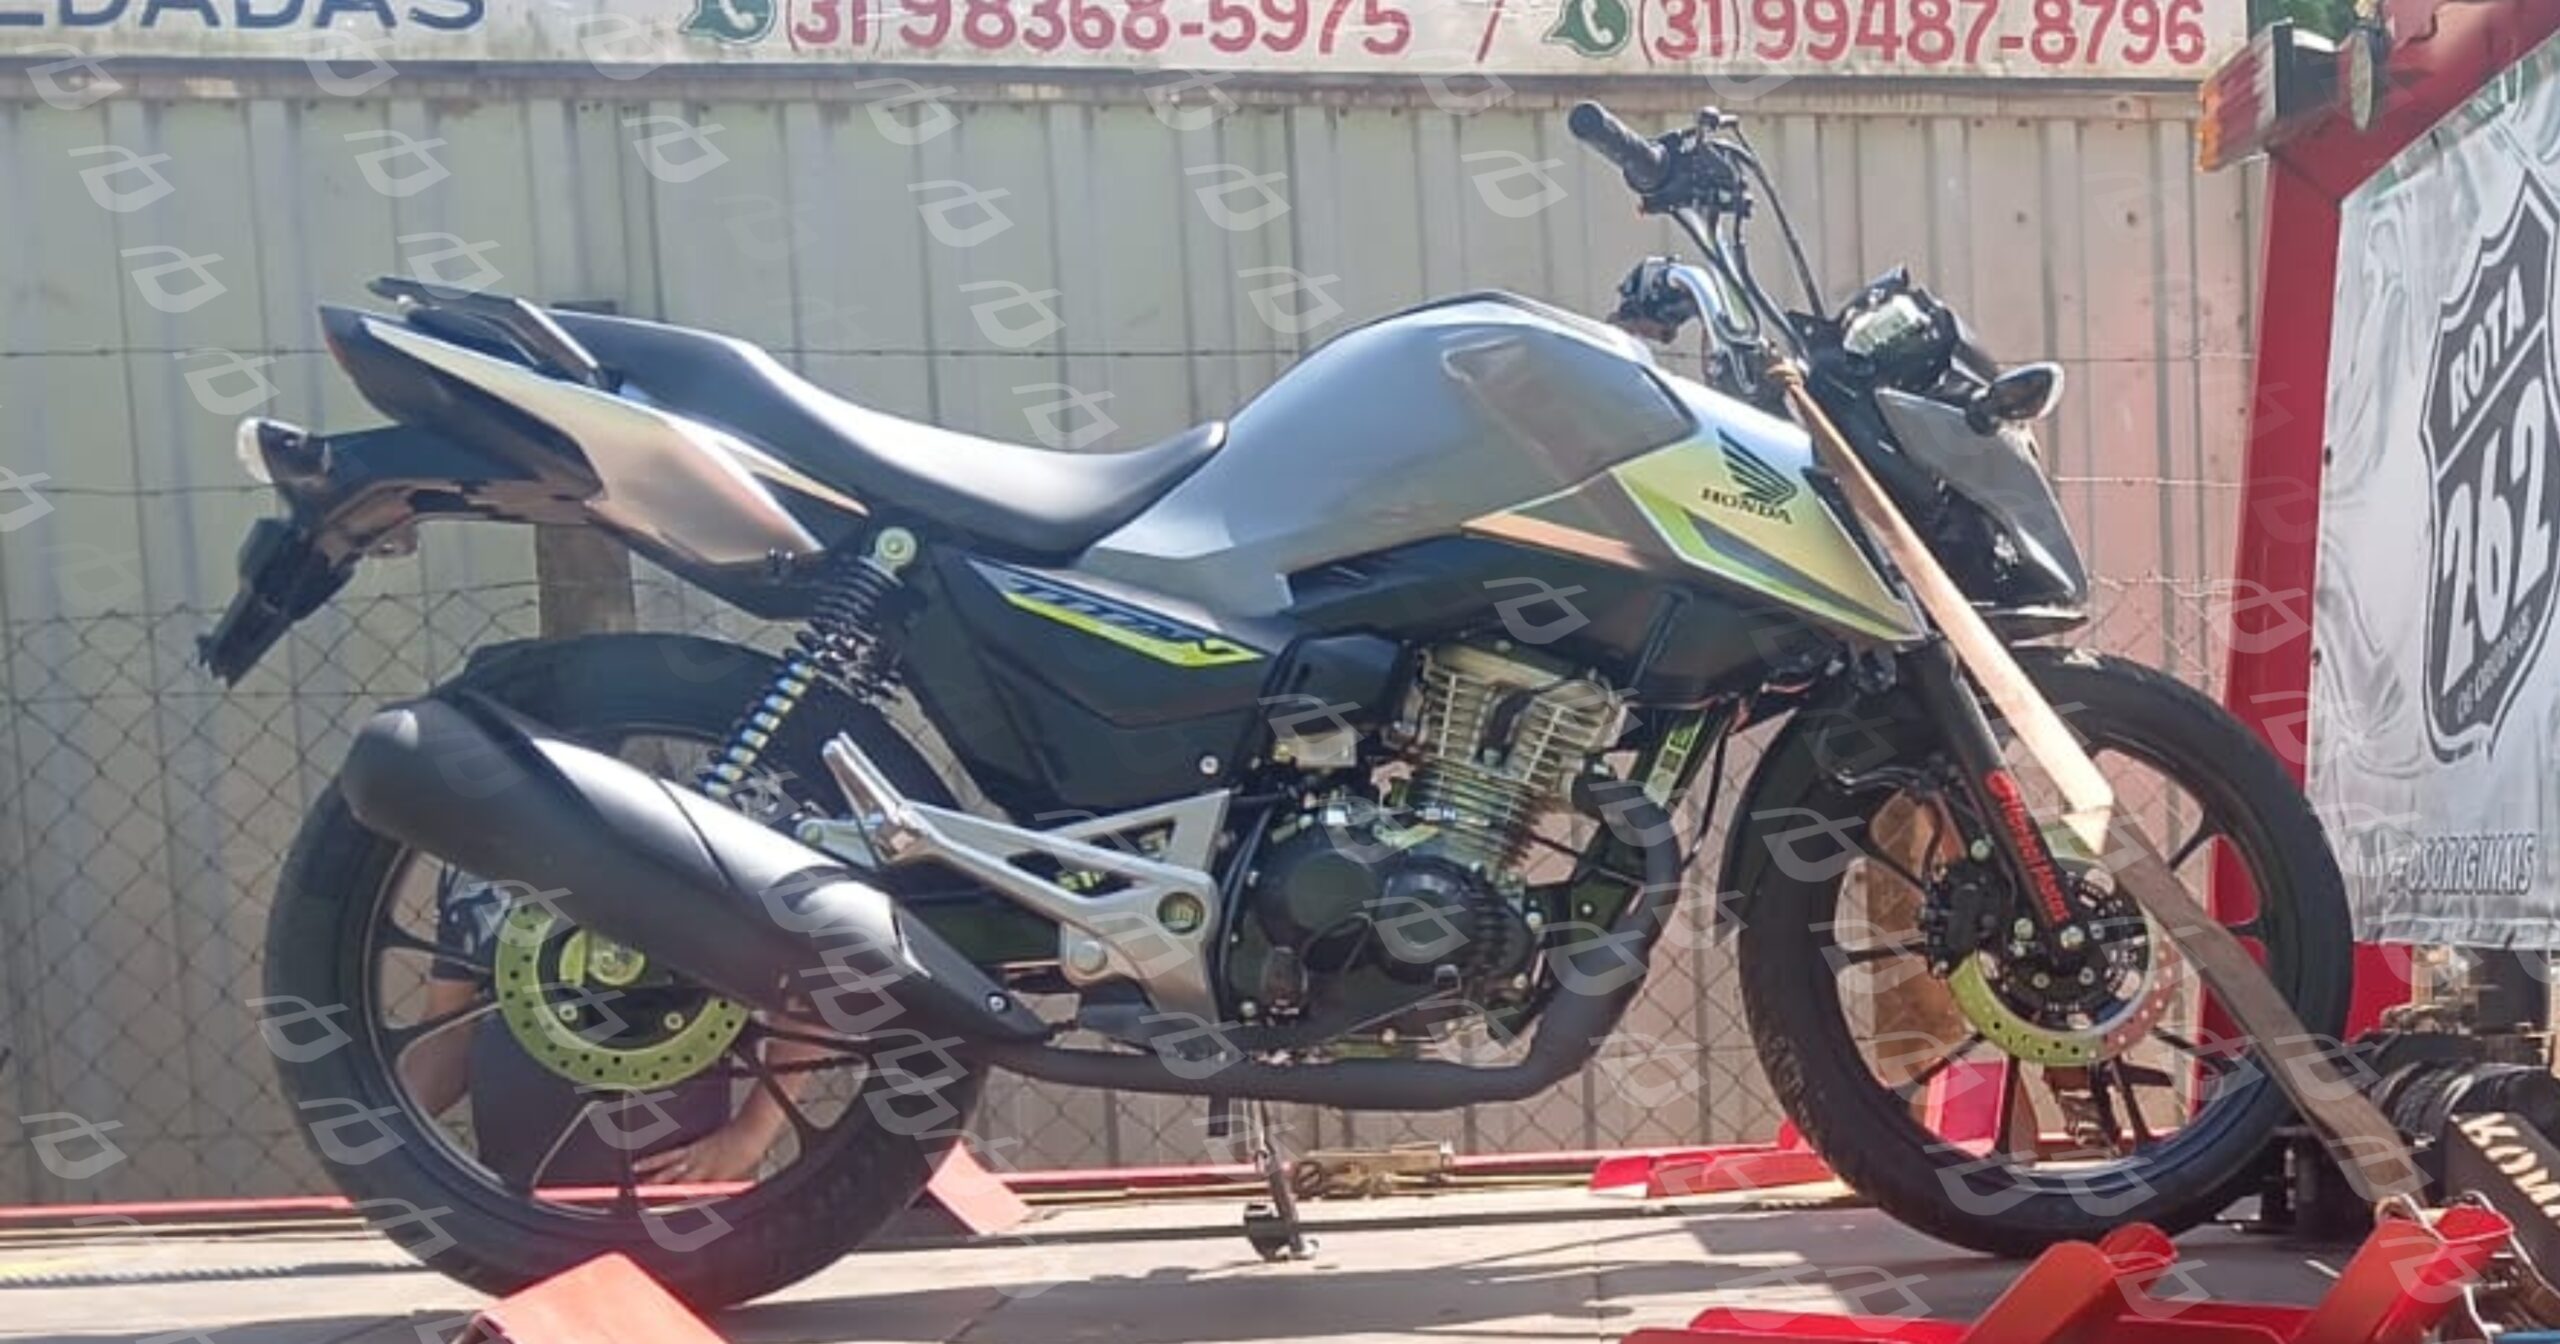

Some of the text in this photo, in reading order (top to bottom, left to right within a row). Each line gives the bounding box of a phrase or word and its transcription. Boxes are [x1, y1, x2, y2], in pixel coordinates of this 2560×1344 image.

[2451, 264, 2526, 432] ROTA
[1702, 488, 1792, 525] HONDA
[2442, 376, 2551, 697] 262
[2460, 1113, 2560, 1224] KOM
